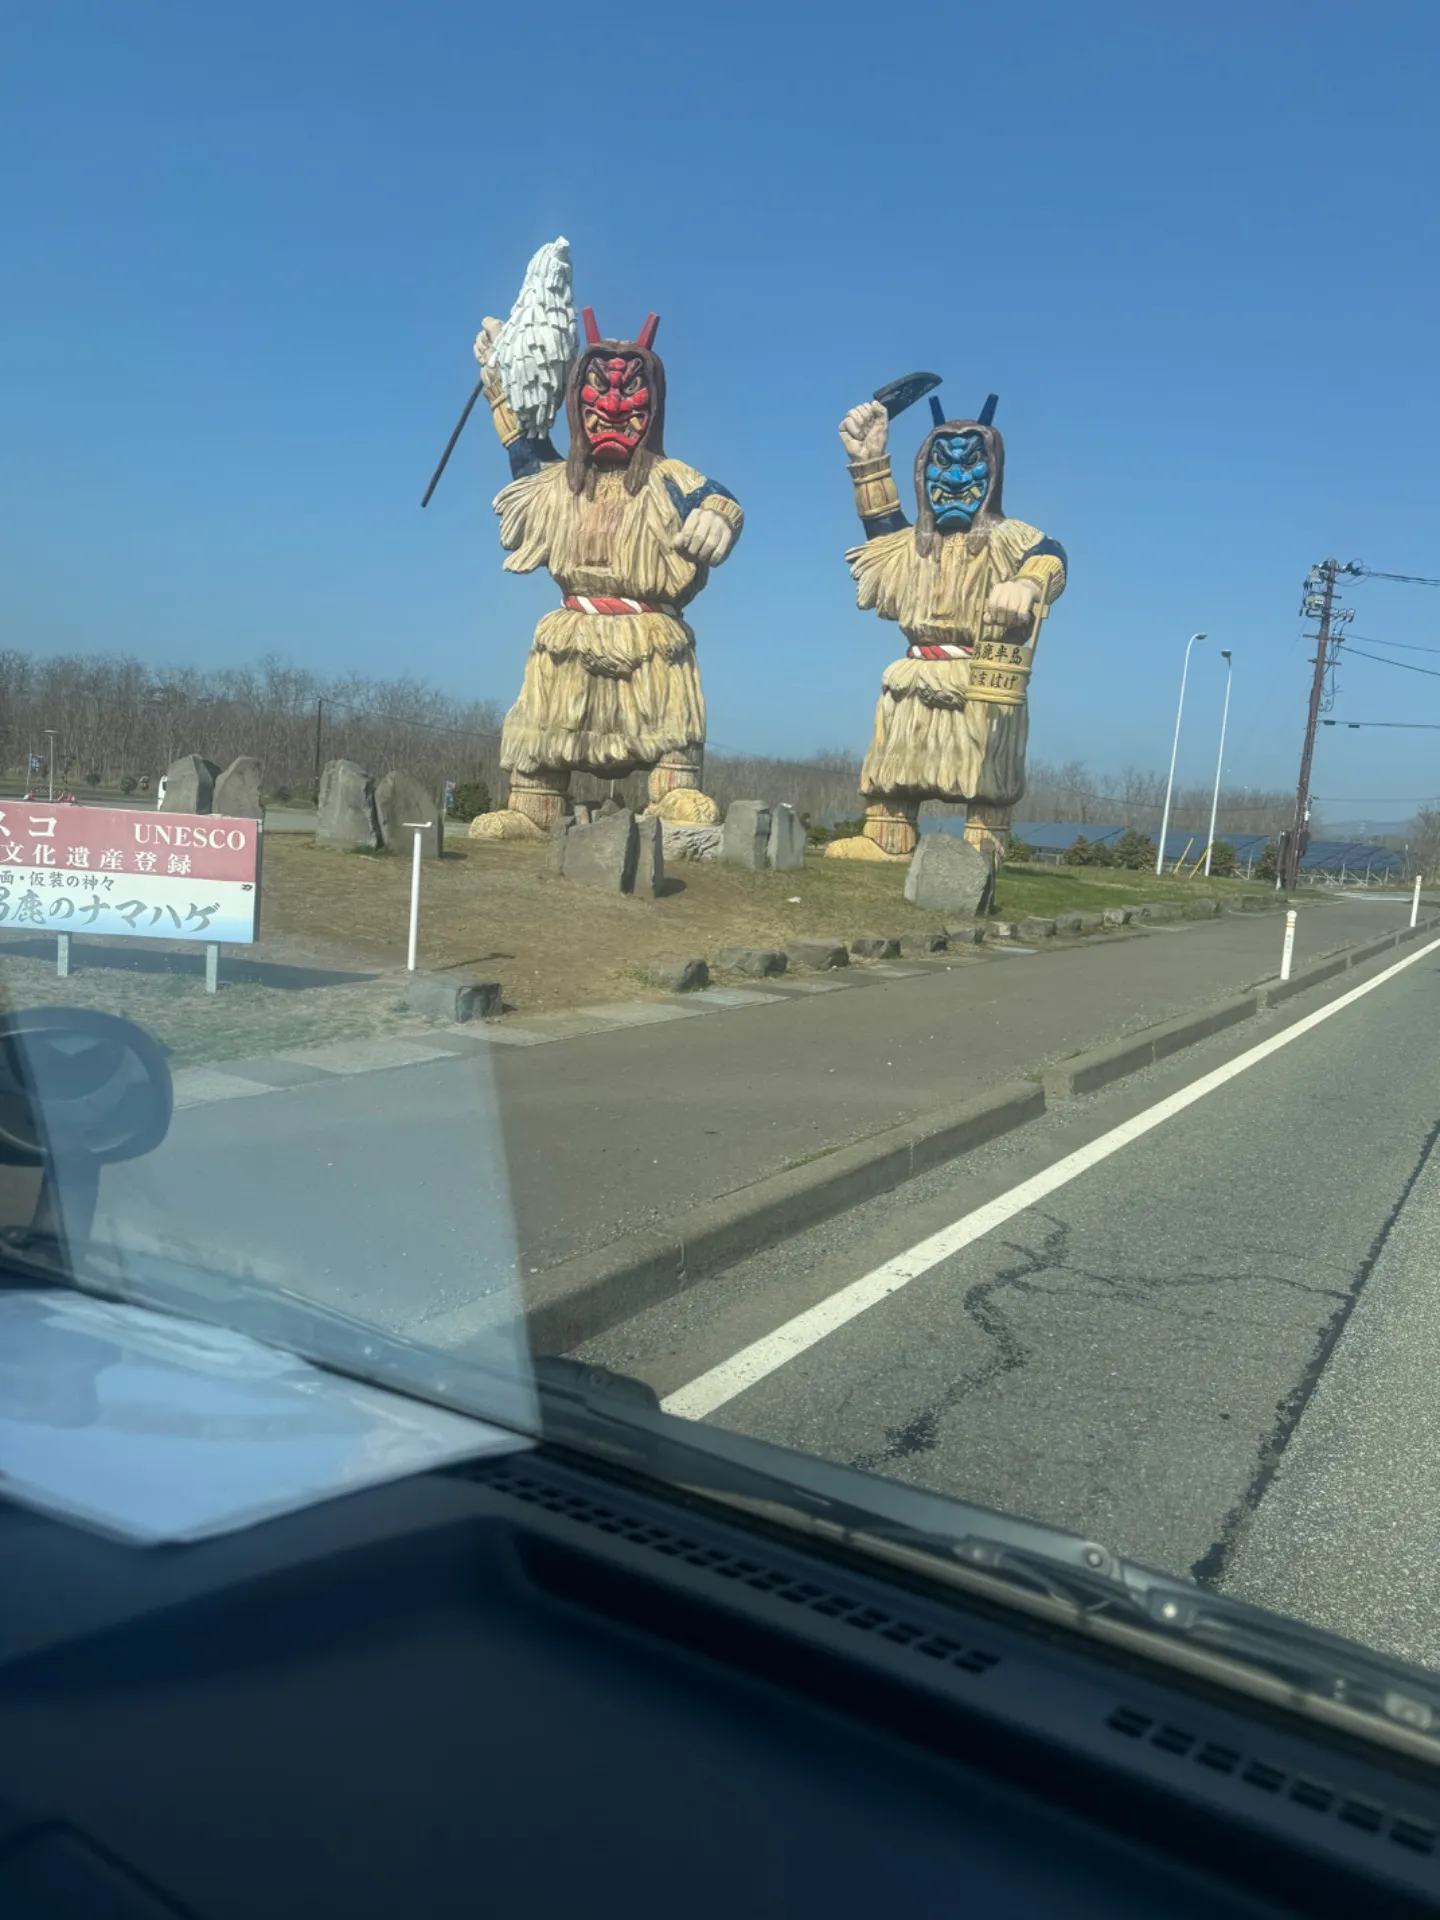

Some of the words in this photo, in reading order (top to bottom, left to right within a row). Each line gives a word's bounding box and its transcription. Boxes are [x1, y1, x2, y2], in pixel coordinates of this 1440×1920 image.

[133, 823, 246, 851] UNESCO
[0, 840, 193, 875] 文化遺産登録
